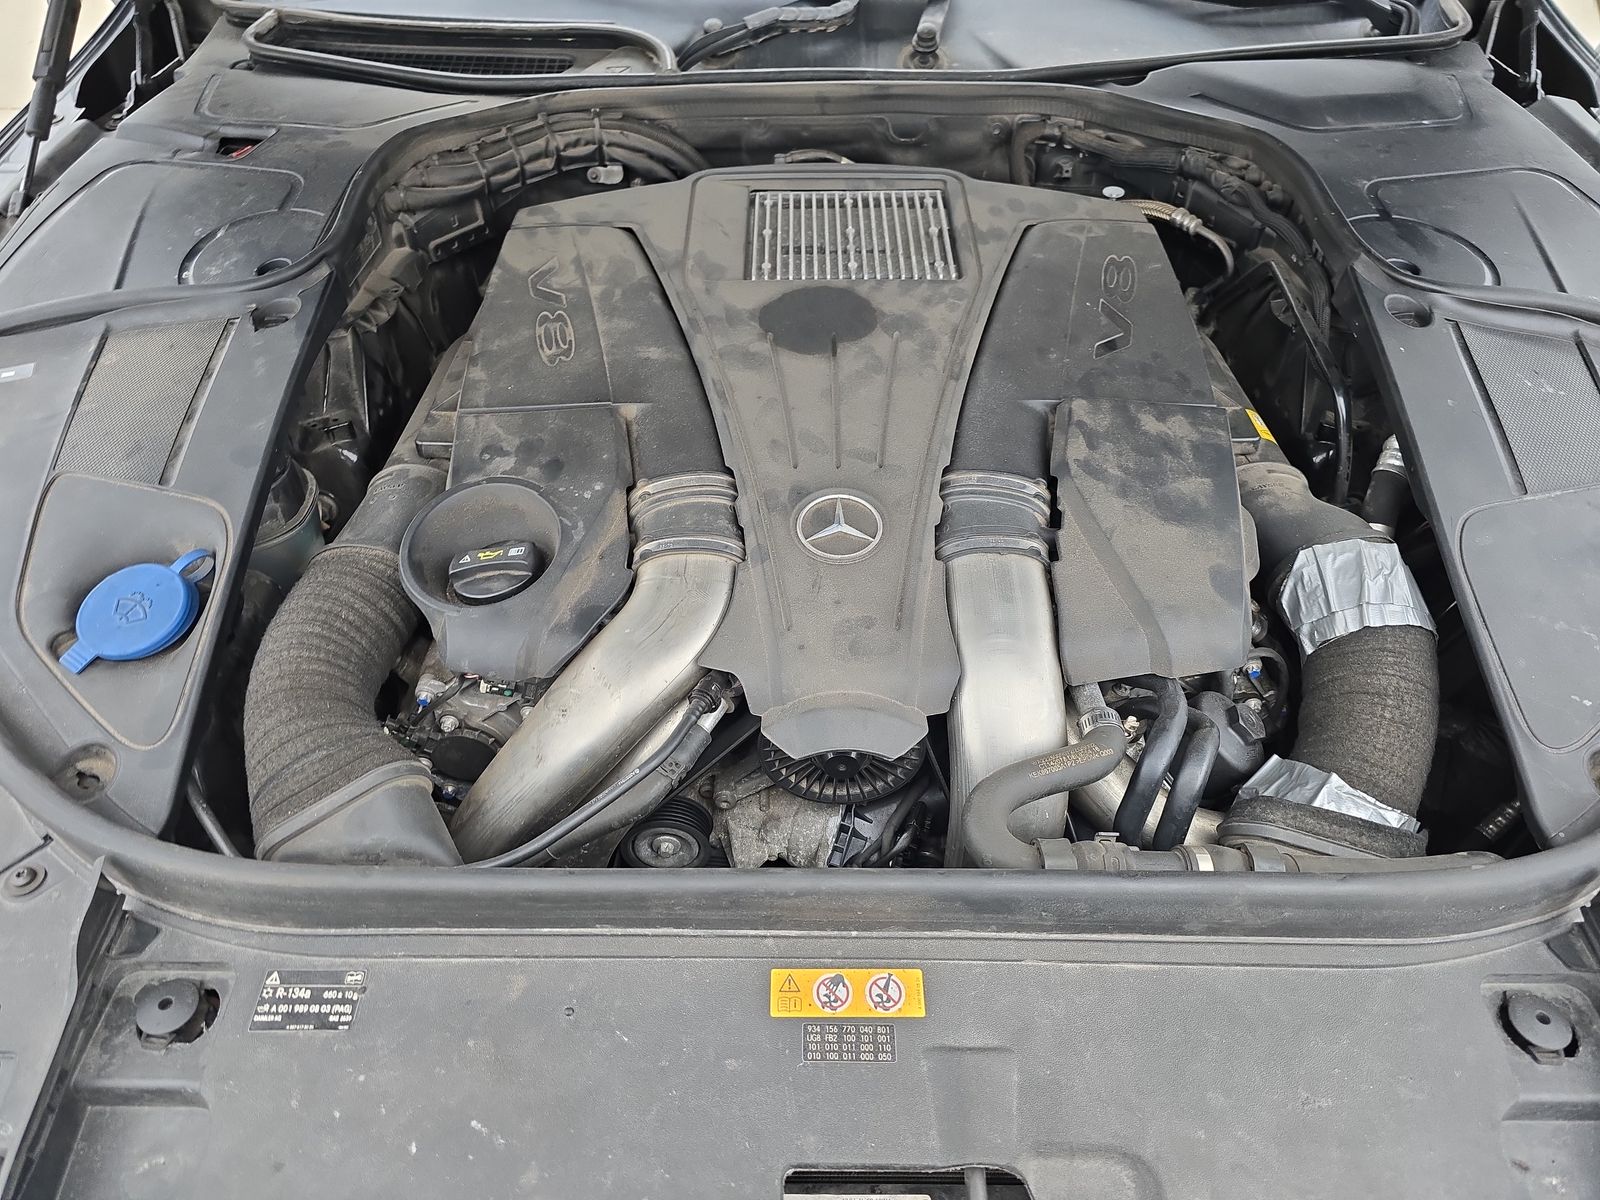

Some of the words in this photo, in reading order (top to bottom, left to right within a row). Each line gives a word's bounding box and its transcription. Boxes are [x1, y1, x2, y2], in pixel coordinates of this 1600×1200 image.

[528, 256, 575, 367] V8
[1093, 254, 1137, 360] V8
[276, 986, 312, 999] R-134a
[278, 1004, 292, 1013] 001
[807, 1025, 821, 1033] 934
[825, 1025, 838, 1033] 156
[806, 1034, 821, 1042] UG8
[825, 1034, 838, 1042] FB2
[843, 1034, 856, 1042] 100
[861, 1034, 873, 1042] 101
[877, 1035, 890, 1043] 001
[808, 1043, 820, 1051] 101
[824, 1043, 839, 1051] 010
[842, 1043, 856, 1051] 011
[860, 1043, 874, 1051] 000
[878, 1044, 891, 1052] 110
[807, 1052, 821, 1060] 010
[826, 1052, 839, 1060] 100
[842, 1052, 856, 1060] 011
[860, 1052, 874, 1060] 000
[878, 1052, 892, 1061] 050
